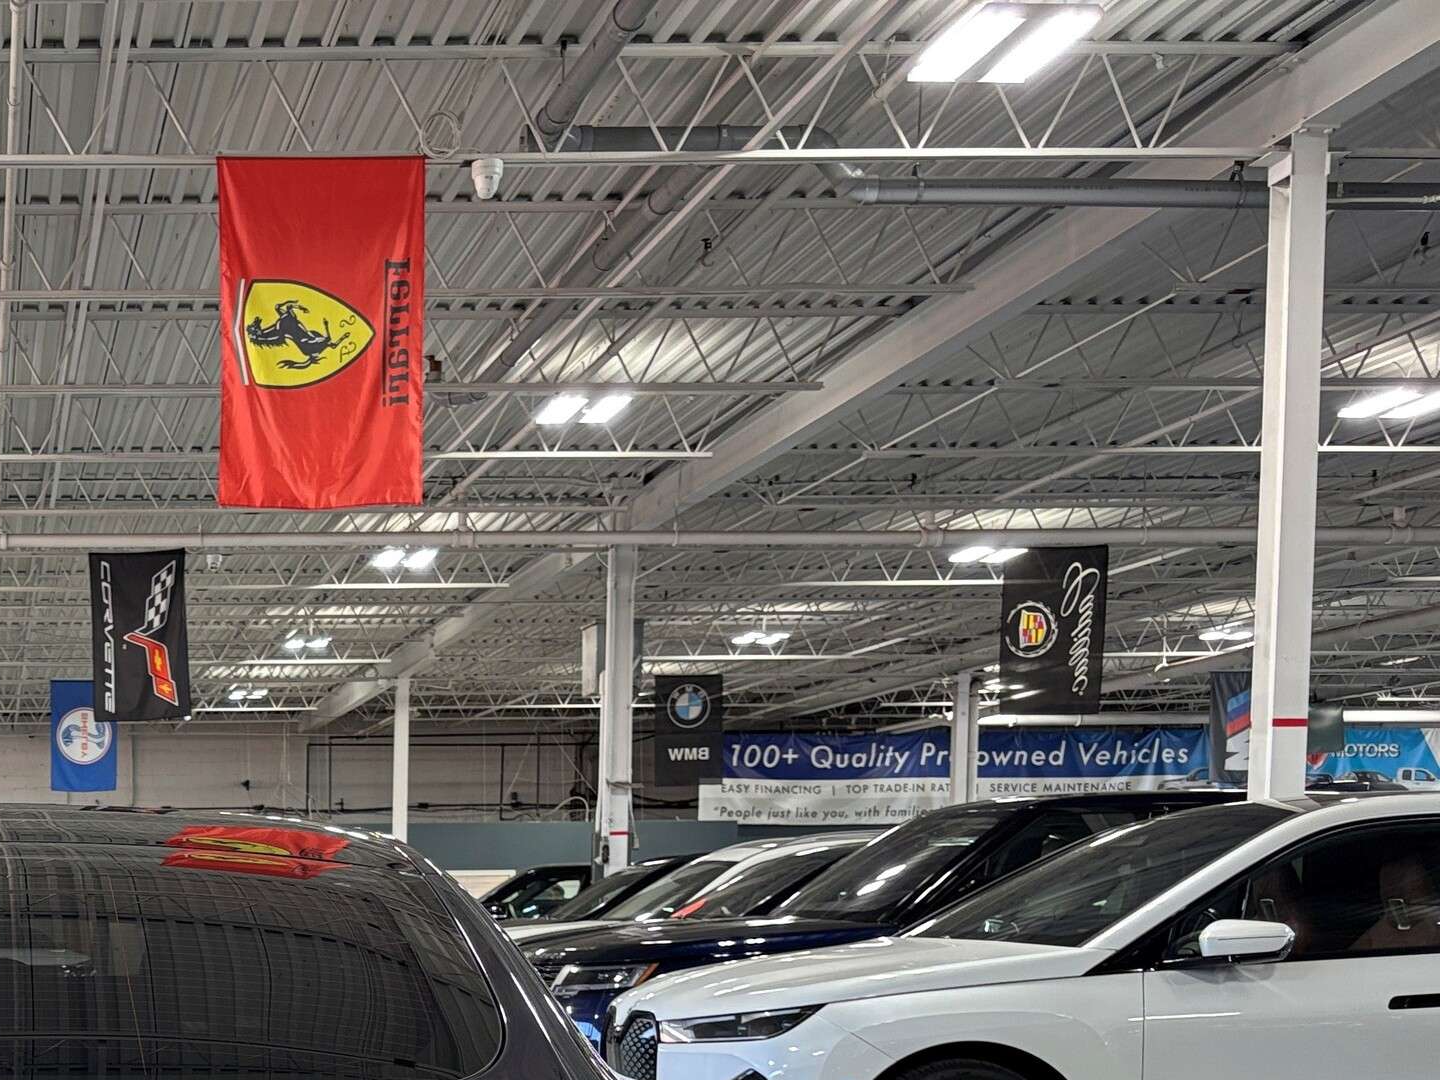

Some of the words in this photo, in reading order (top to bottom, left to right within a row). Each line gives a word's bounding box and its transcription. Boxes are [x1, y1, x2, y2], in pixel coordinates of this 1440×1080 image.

[101, 561, 115, 713] CORVETTE
[731, 744, 800, 768] 100+
[810, 742, 910, 774] Quality
[1078, 738, 1189, 765] Vehicles
[720, 783, 750, 794] EASY
[754, 784, 822, 795] FINANCING
[845, 784, 869, 795] TOP
[873, 783, 926, 794] TRADE-IN
[989, 782, 1038, 794] SERVICE
[1042, 781, 1132, 793] MAINTENANCE
[767, 807, 792, 820] just
[795, 806, 819, 818] like
[854, 806, 880, 818] with
